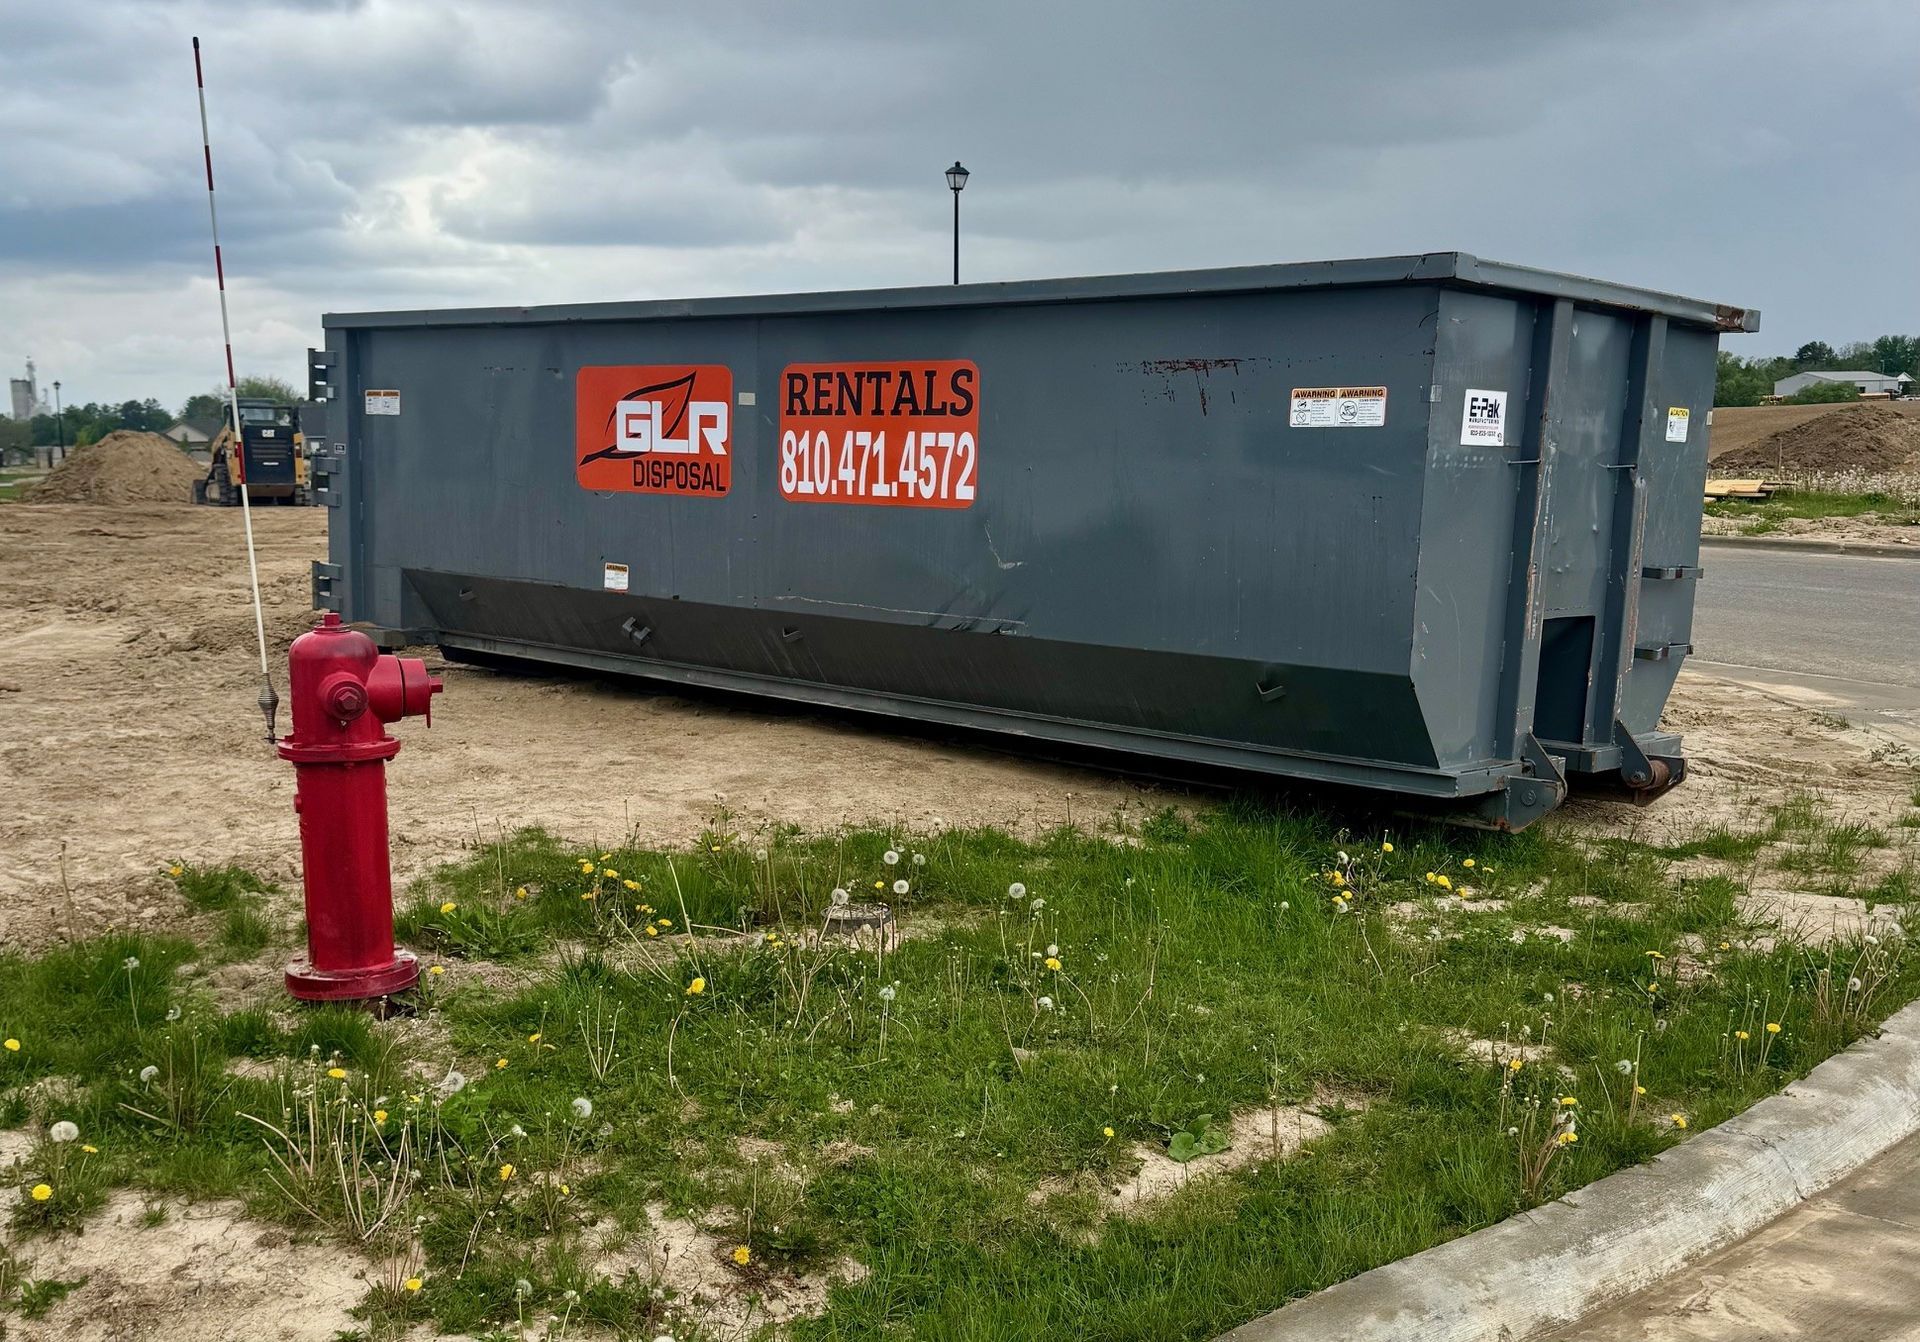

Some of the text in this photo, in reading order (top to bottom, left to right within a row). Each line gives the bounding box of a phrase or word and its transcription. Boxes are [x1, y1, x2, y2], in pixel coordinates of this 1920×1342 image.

[786, 369, 973, 416] RENTALS
[1346, 389, 1384, 397] WARNING
[1470, 397, 1500, 418] E-Pak
[616, 400, 729, 455] GLR
[633, 460, 726, 491] DISPOSAL
[781, 430, 975, 500] 810.471.4572
